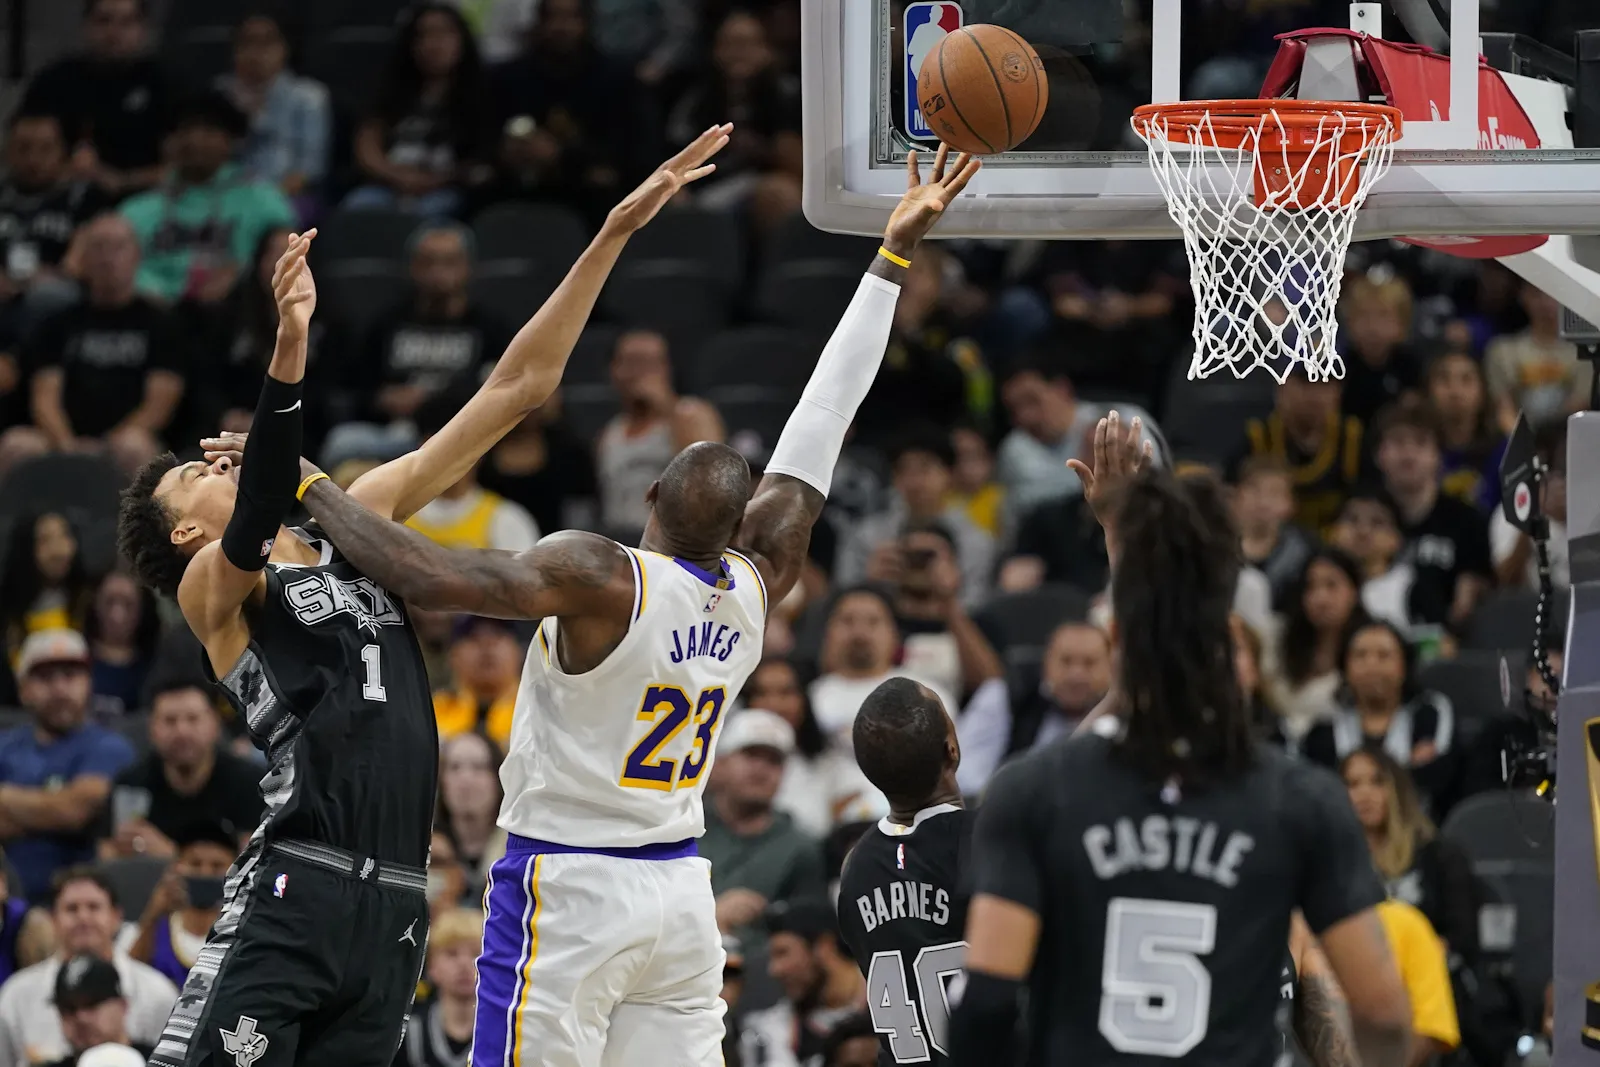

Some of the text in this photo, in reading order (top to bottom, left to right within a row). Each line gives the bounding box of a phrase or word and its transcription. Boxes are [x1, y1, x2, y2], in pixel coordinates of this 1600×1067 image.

[361, 644, 387, 702] 1
[670, 621, 741, 664] JAMES
[619, 683, 727, 792] 23
[1082, 815, 1256, 888] CASTLE
[856, 880, 950, 933] BARNES
[1098, 897, 1218, 1058] 5
